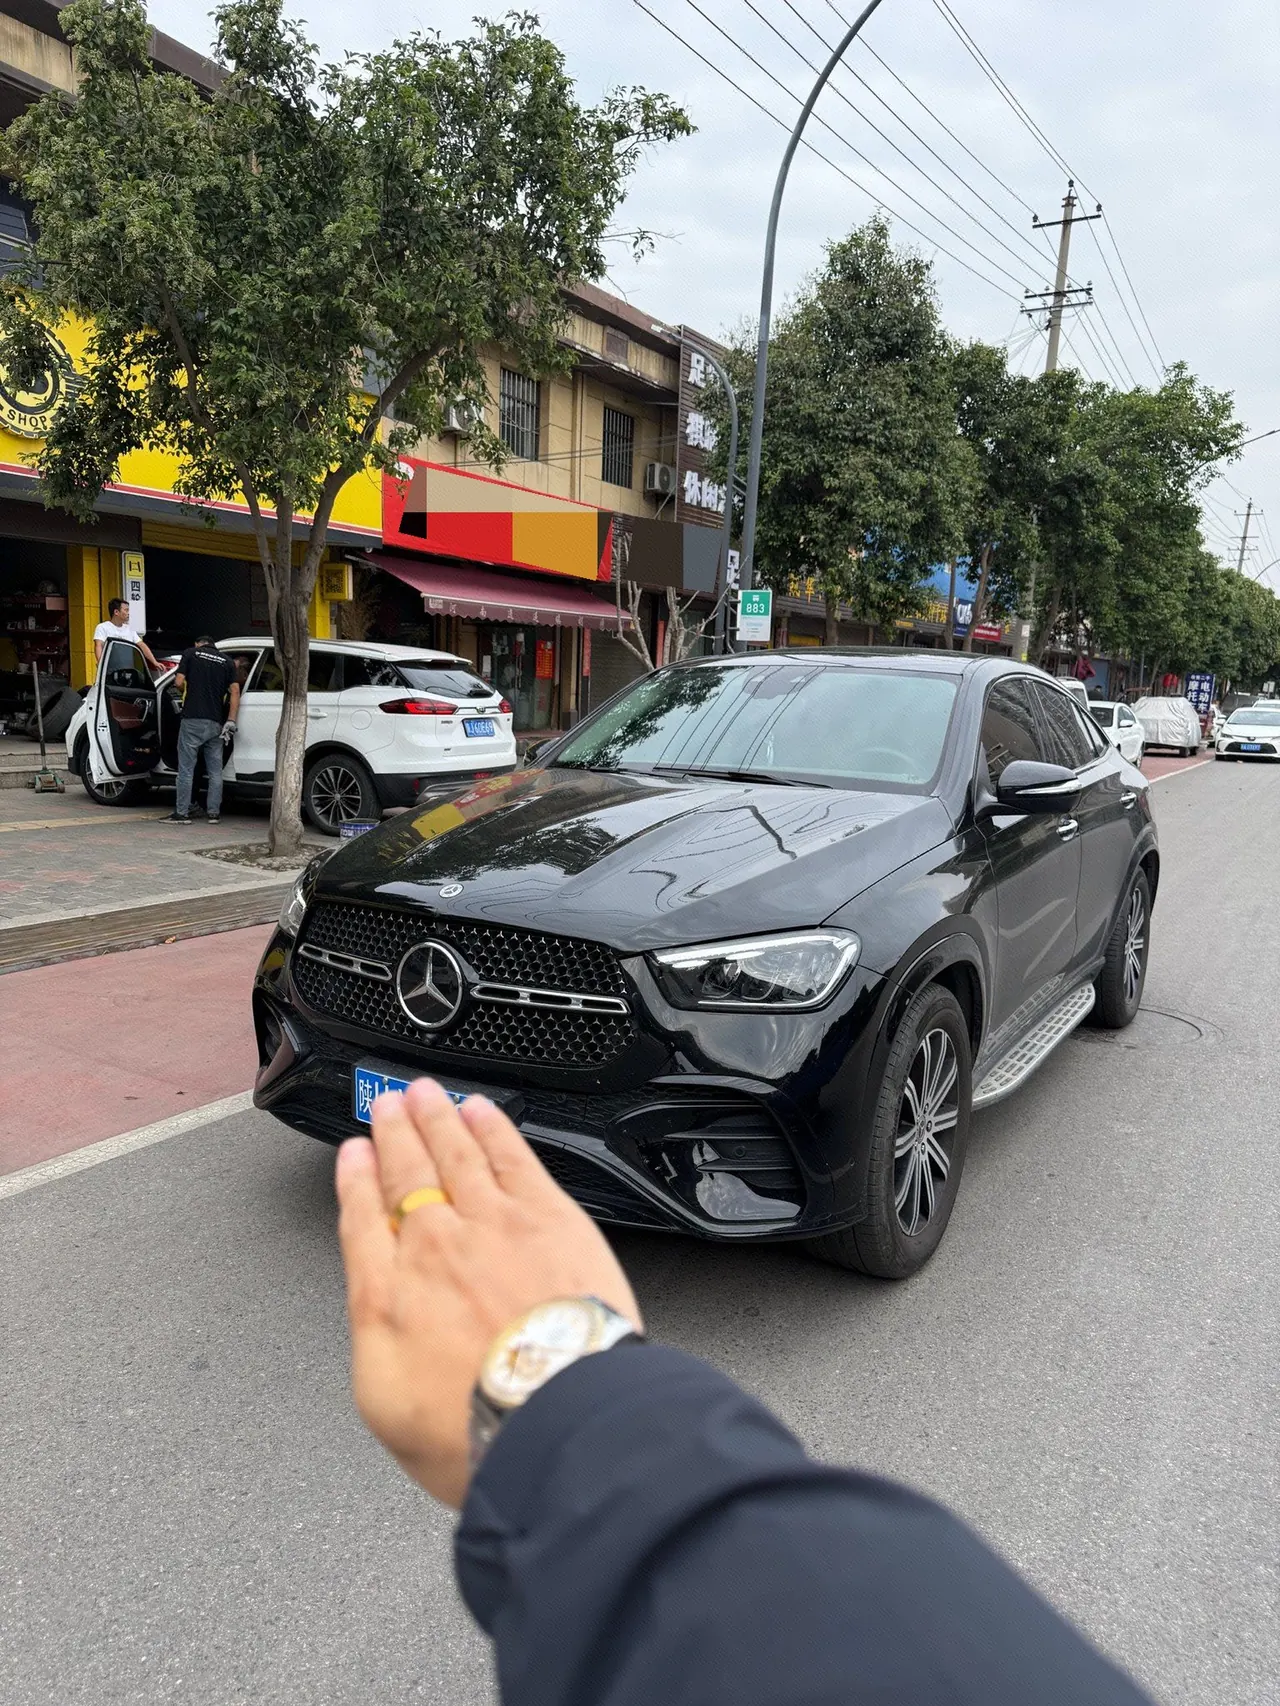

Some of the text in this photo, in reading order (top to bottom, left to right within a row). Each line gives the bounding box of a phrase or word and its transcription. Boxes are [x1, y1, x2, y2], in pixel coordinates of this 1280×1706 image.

[7, 409, 48, 430] SHOP
[746, 603, 765, 614] 883
[1198, 681, 1210, 713] 电动车
